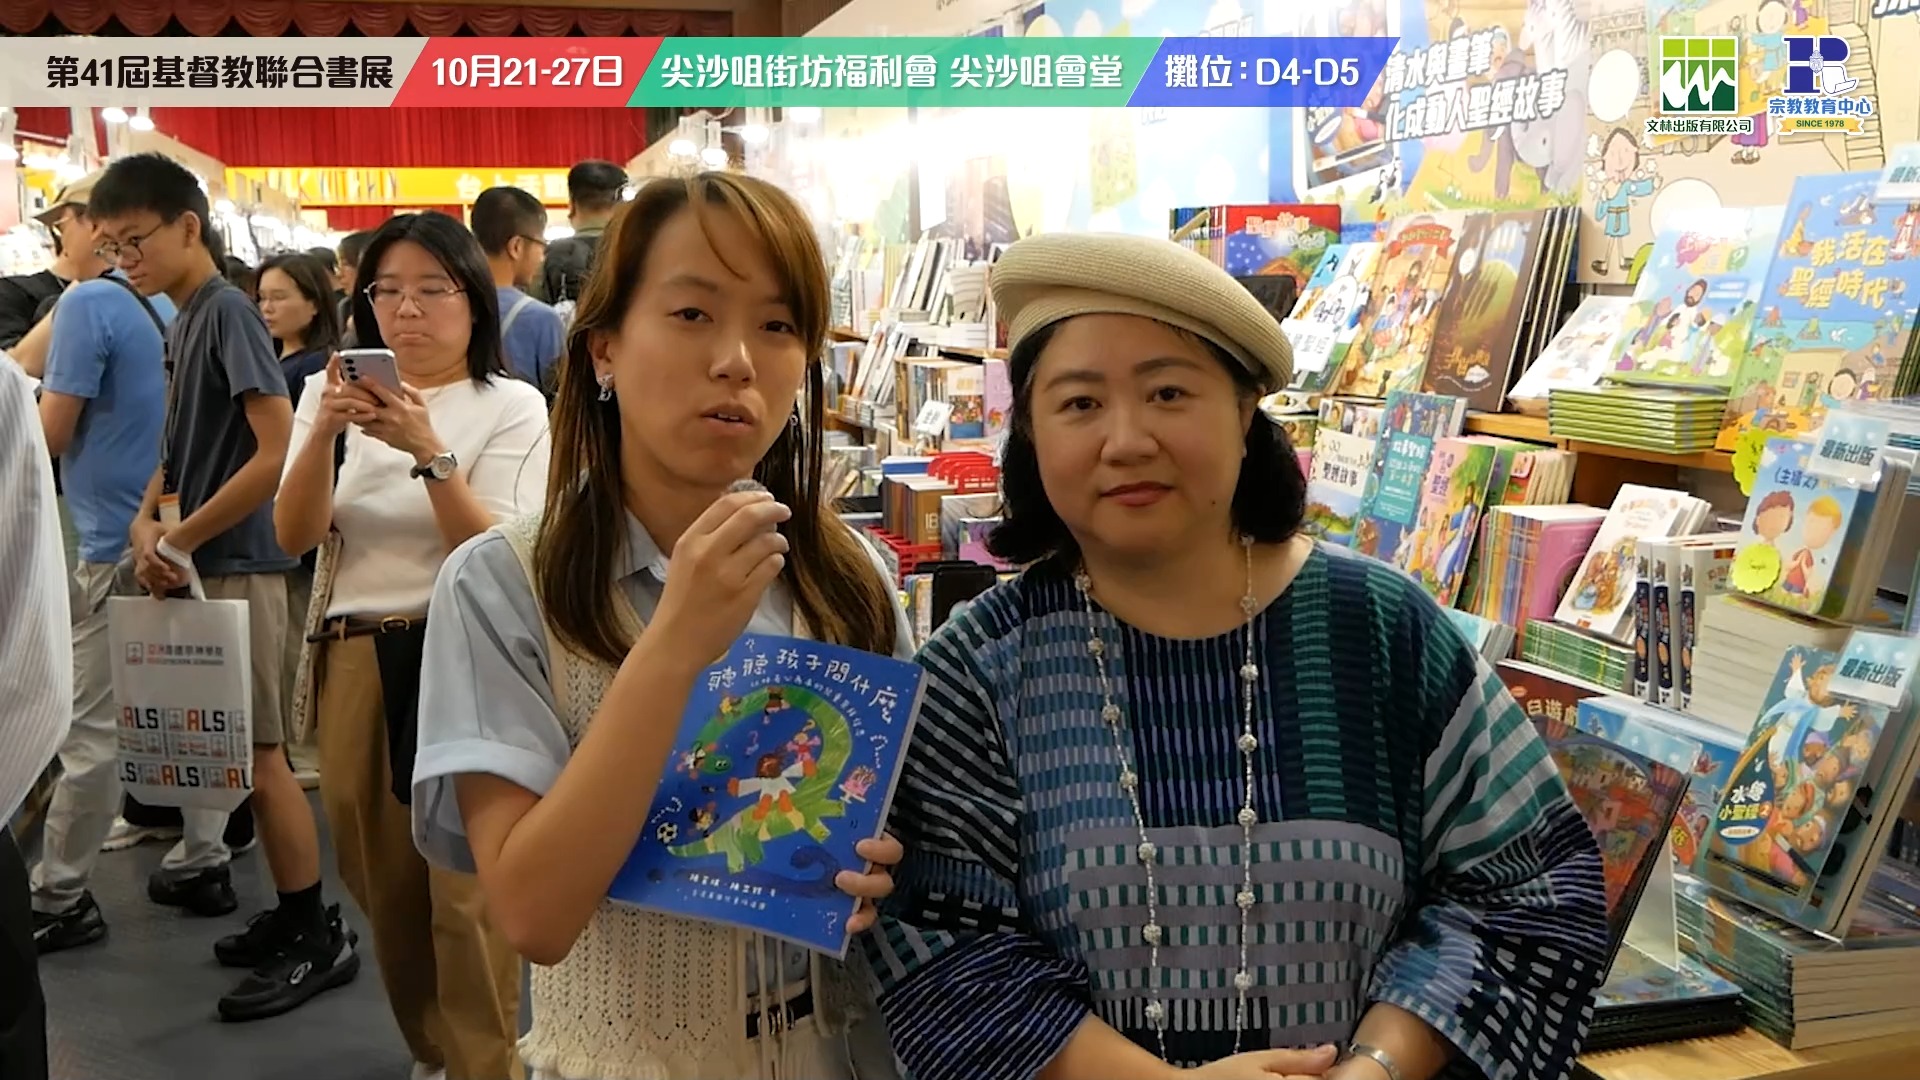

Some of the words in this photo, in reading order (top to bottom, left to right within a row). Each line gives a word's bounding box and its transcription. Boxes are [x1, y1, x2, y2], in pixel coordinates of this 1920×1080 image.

[1384, 30, 1493, 94] 清水與畫筆
[1385, 68, 1568, 142] 化成動人聖經故事
[1811, 230, 1890, 267] 我活在
[1785, 266, 1890, 309] 聖經時代
[1820, 438, 1878, 467] 最新出版
[708, 647, 899, 725] 聽聽孩子問什麼
[1840, 656, 1908, 689] 最新出版
[123, 706, 159, 730] ALS
[187, 709, 226, 732] ALS
[120, 762, 137, 783] S
[162, 764, 201, 788] ALS
